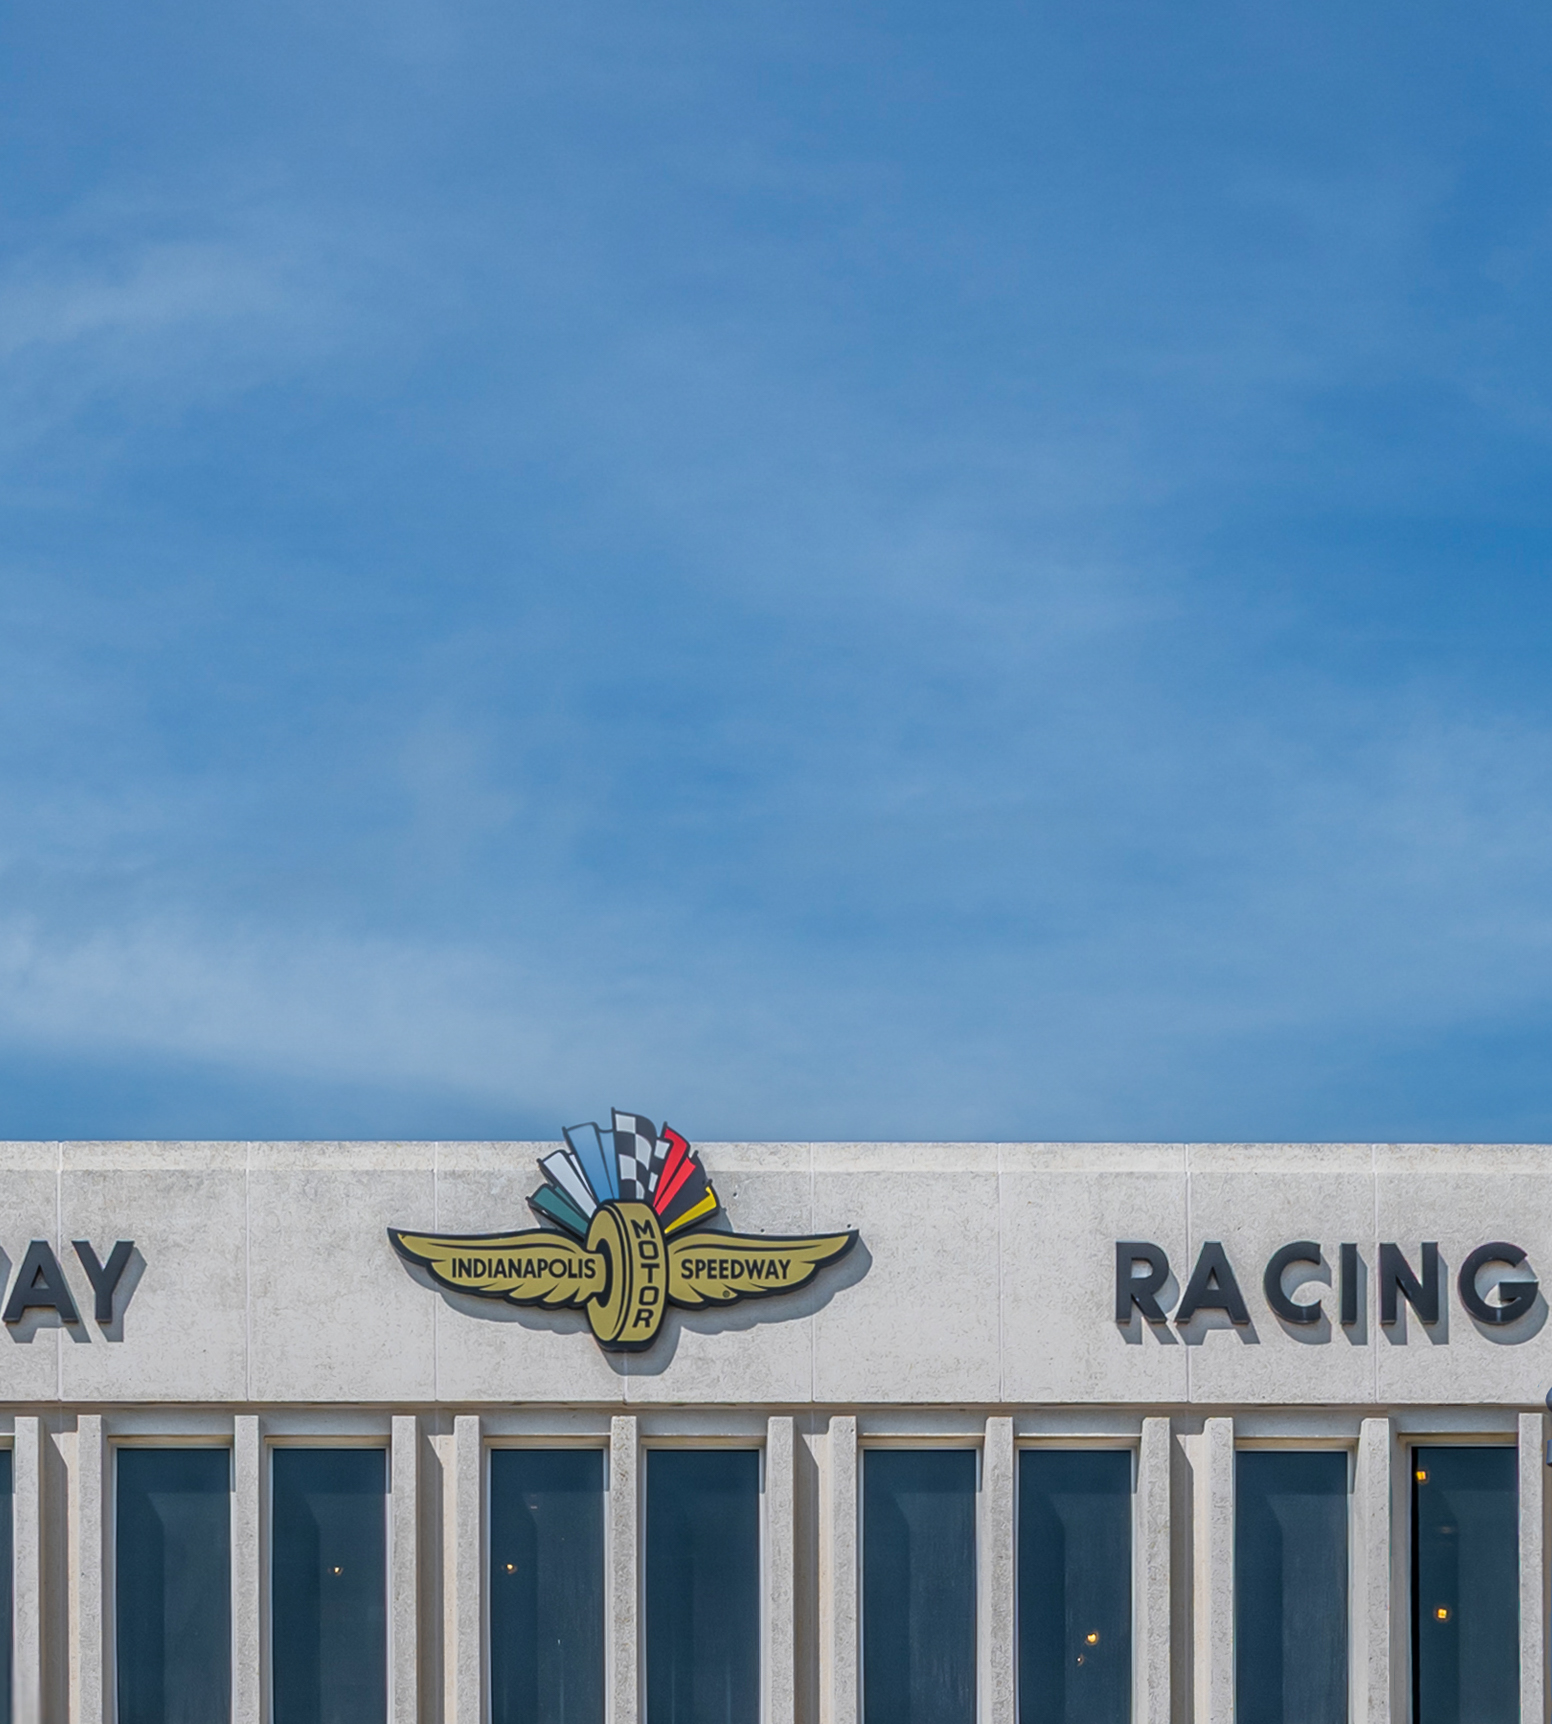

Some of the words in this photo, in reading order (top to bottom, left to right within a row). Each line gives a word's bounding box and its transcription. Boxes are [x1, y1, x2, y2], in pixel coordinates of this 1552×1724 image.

[451, 1257, 597, 1280] INDIANAPOLIS
[629, 1218, 660, 1330] MOTOR
[680, 1258, 792, 1281] SPEEDWAY
[1113, 1240, 1540, 1327] RACING
